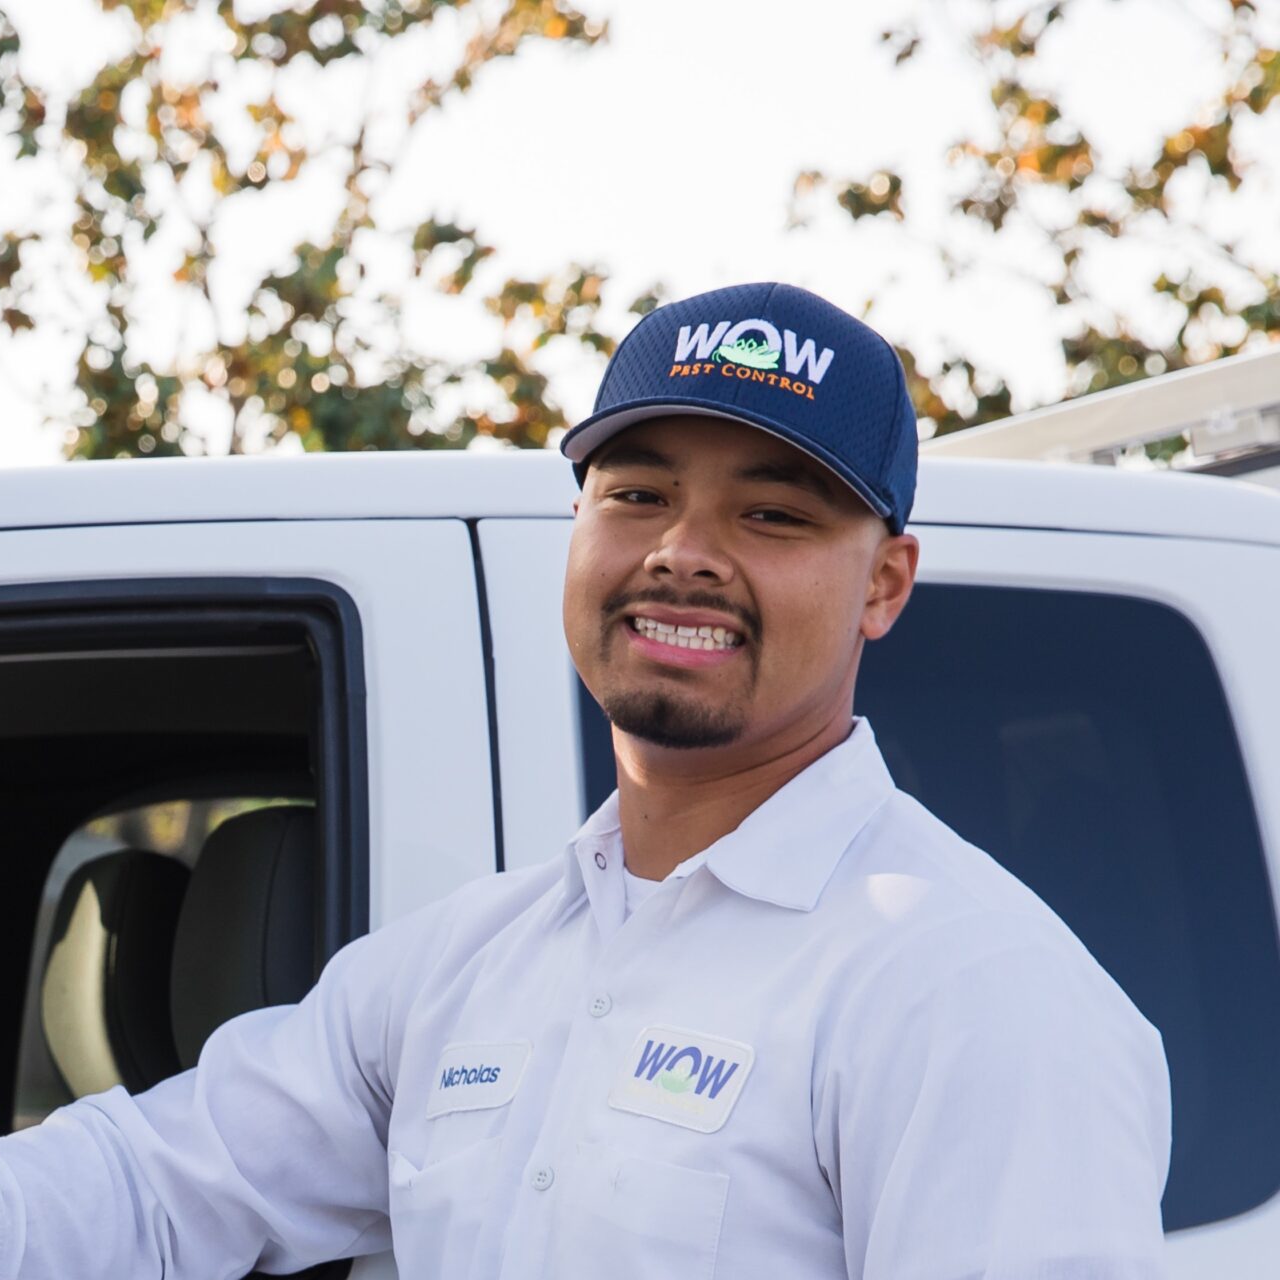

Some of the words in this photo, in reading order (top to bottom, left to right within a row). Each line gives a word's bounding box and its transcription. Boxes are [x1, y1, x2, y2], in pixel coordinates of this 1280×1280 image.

[674, 318, 835, 385] WOW
[669, 363, 715, 378] PEST
[721, 363, 815, 400] CONTROL
[440, 1063, 501, 1090] Nicholas
[634, 1040, 739, 1099] WOW
